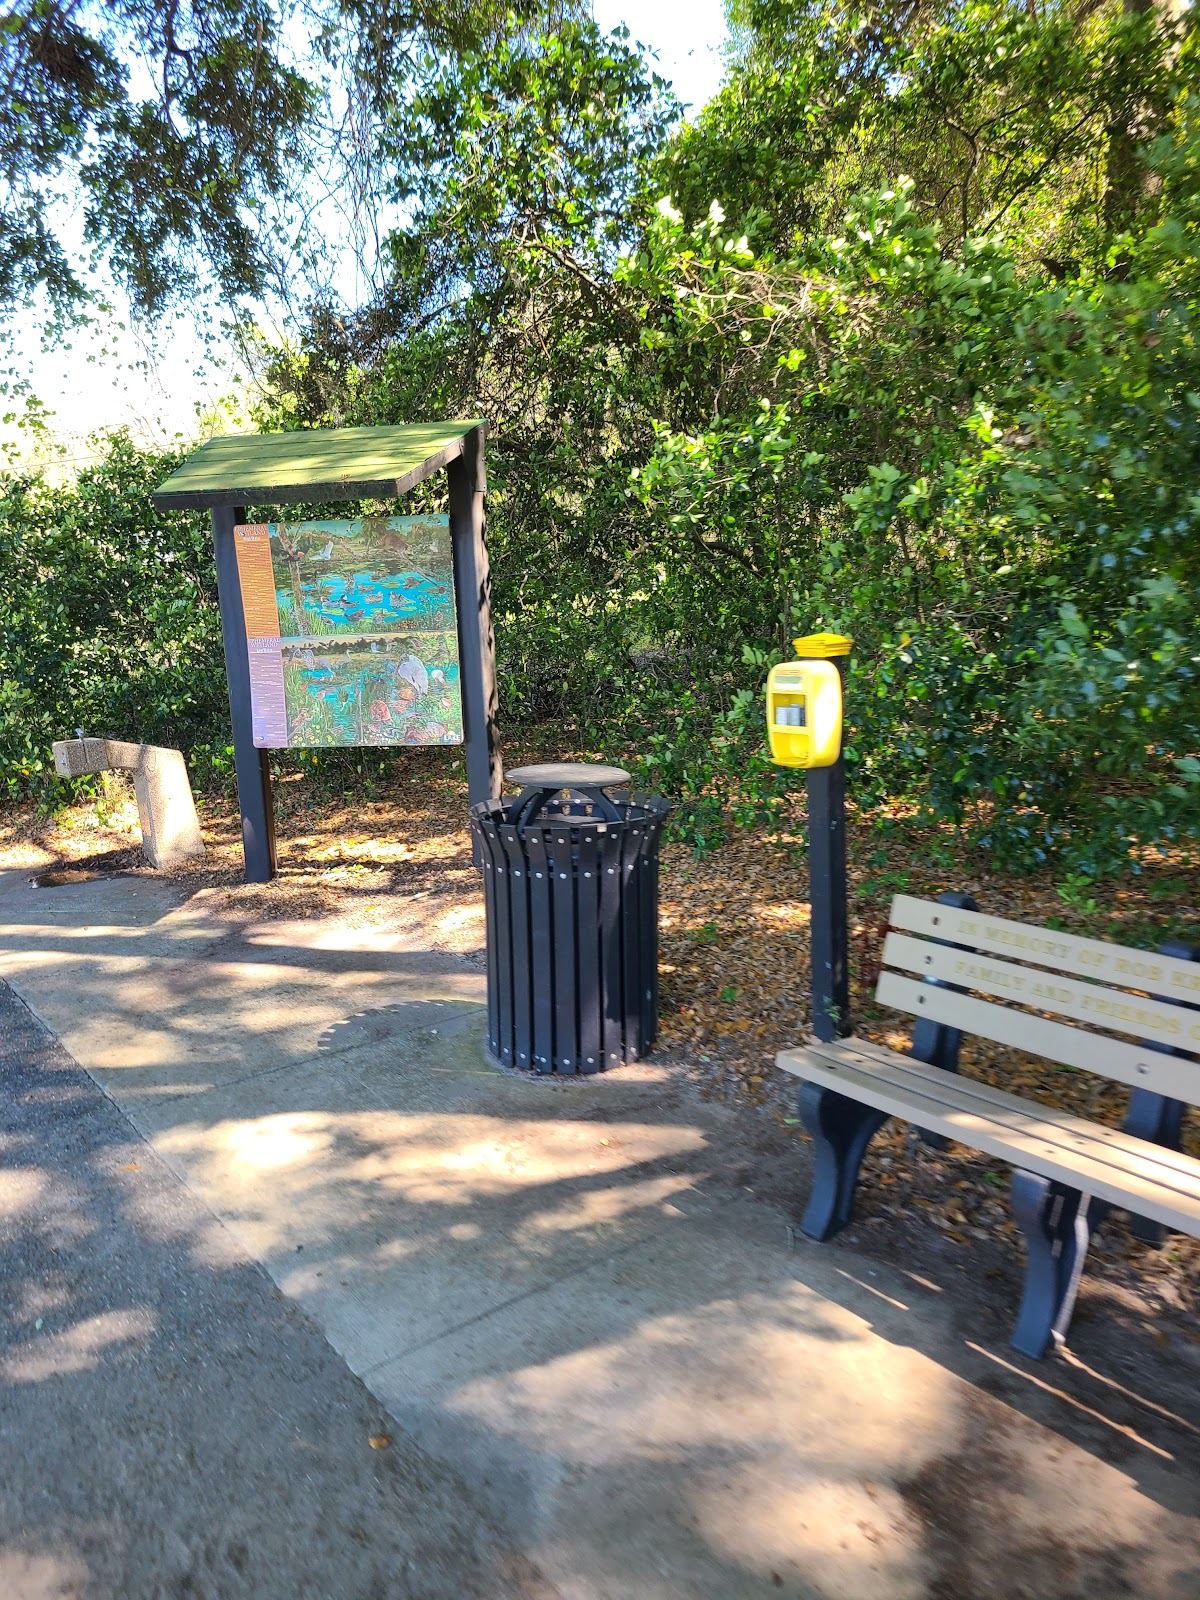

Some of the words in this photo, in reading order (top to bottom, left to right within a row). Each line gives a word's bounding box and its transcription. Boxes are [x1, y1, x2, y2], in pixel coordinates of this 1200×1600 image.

[984, 926, 1071, 959] MEMORY
[1079, 948, 1107, 968] OF
[954, 958, 1026, 991] FAMILY
[1031, 983, 1073, 1004] AND
[1081, 994, 1181, 1035] FRIENDS
